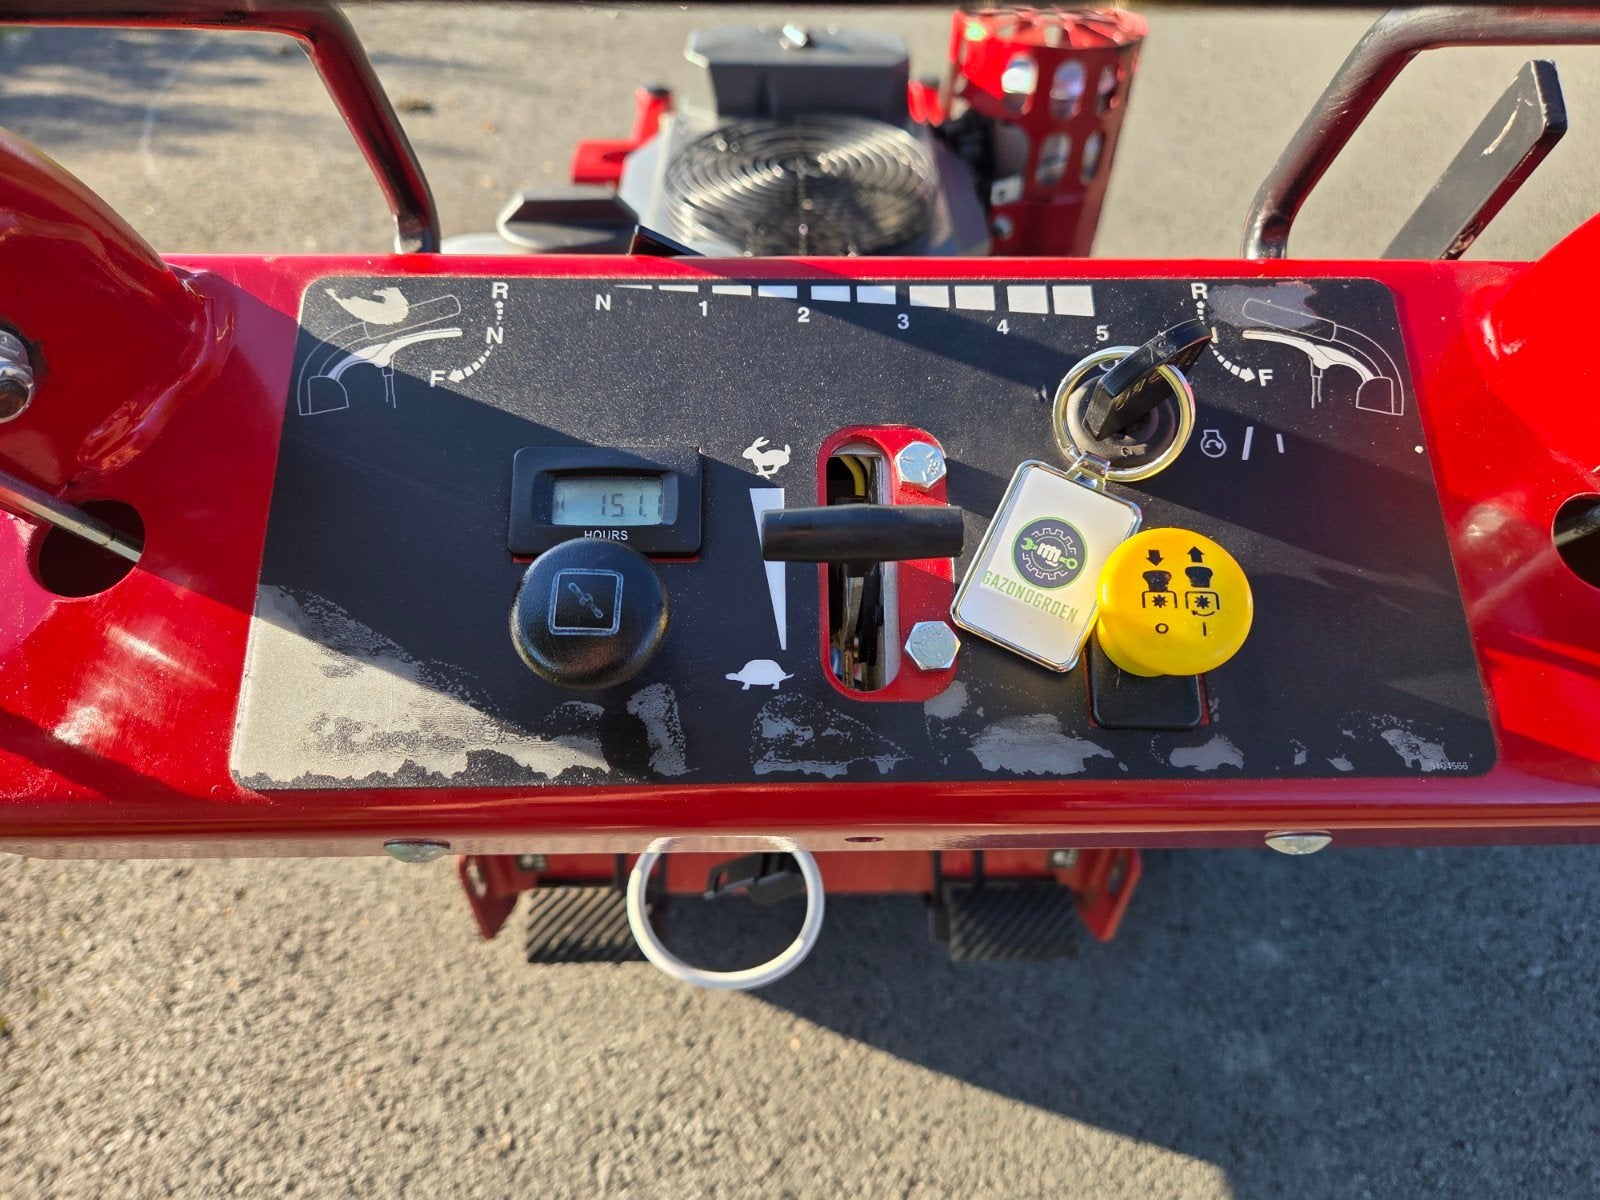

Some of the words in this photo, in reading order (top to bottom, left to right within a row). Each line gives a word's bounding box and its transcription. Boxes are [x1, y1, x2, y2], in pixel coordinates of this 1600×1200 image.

[491, 281, 509, 299] R
[1190, 282, 1209, 300] R
[595, 294, 611, 311] N
[698, 300, 708, 317] 1
[797, 306, 811, 323] 2
[897, 313, 910, 330] 3
[996, 319, 1010, 336] 4
[1096, 325, 1109, 342] 5
[485, 326, 504, 345] N
[430, 369, 446, 388] F
[1258, 368, 1274, 387] F
[584, 530, 628, 540] HOURS
